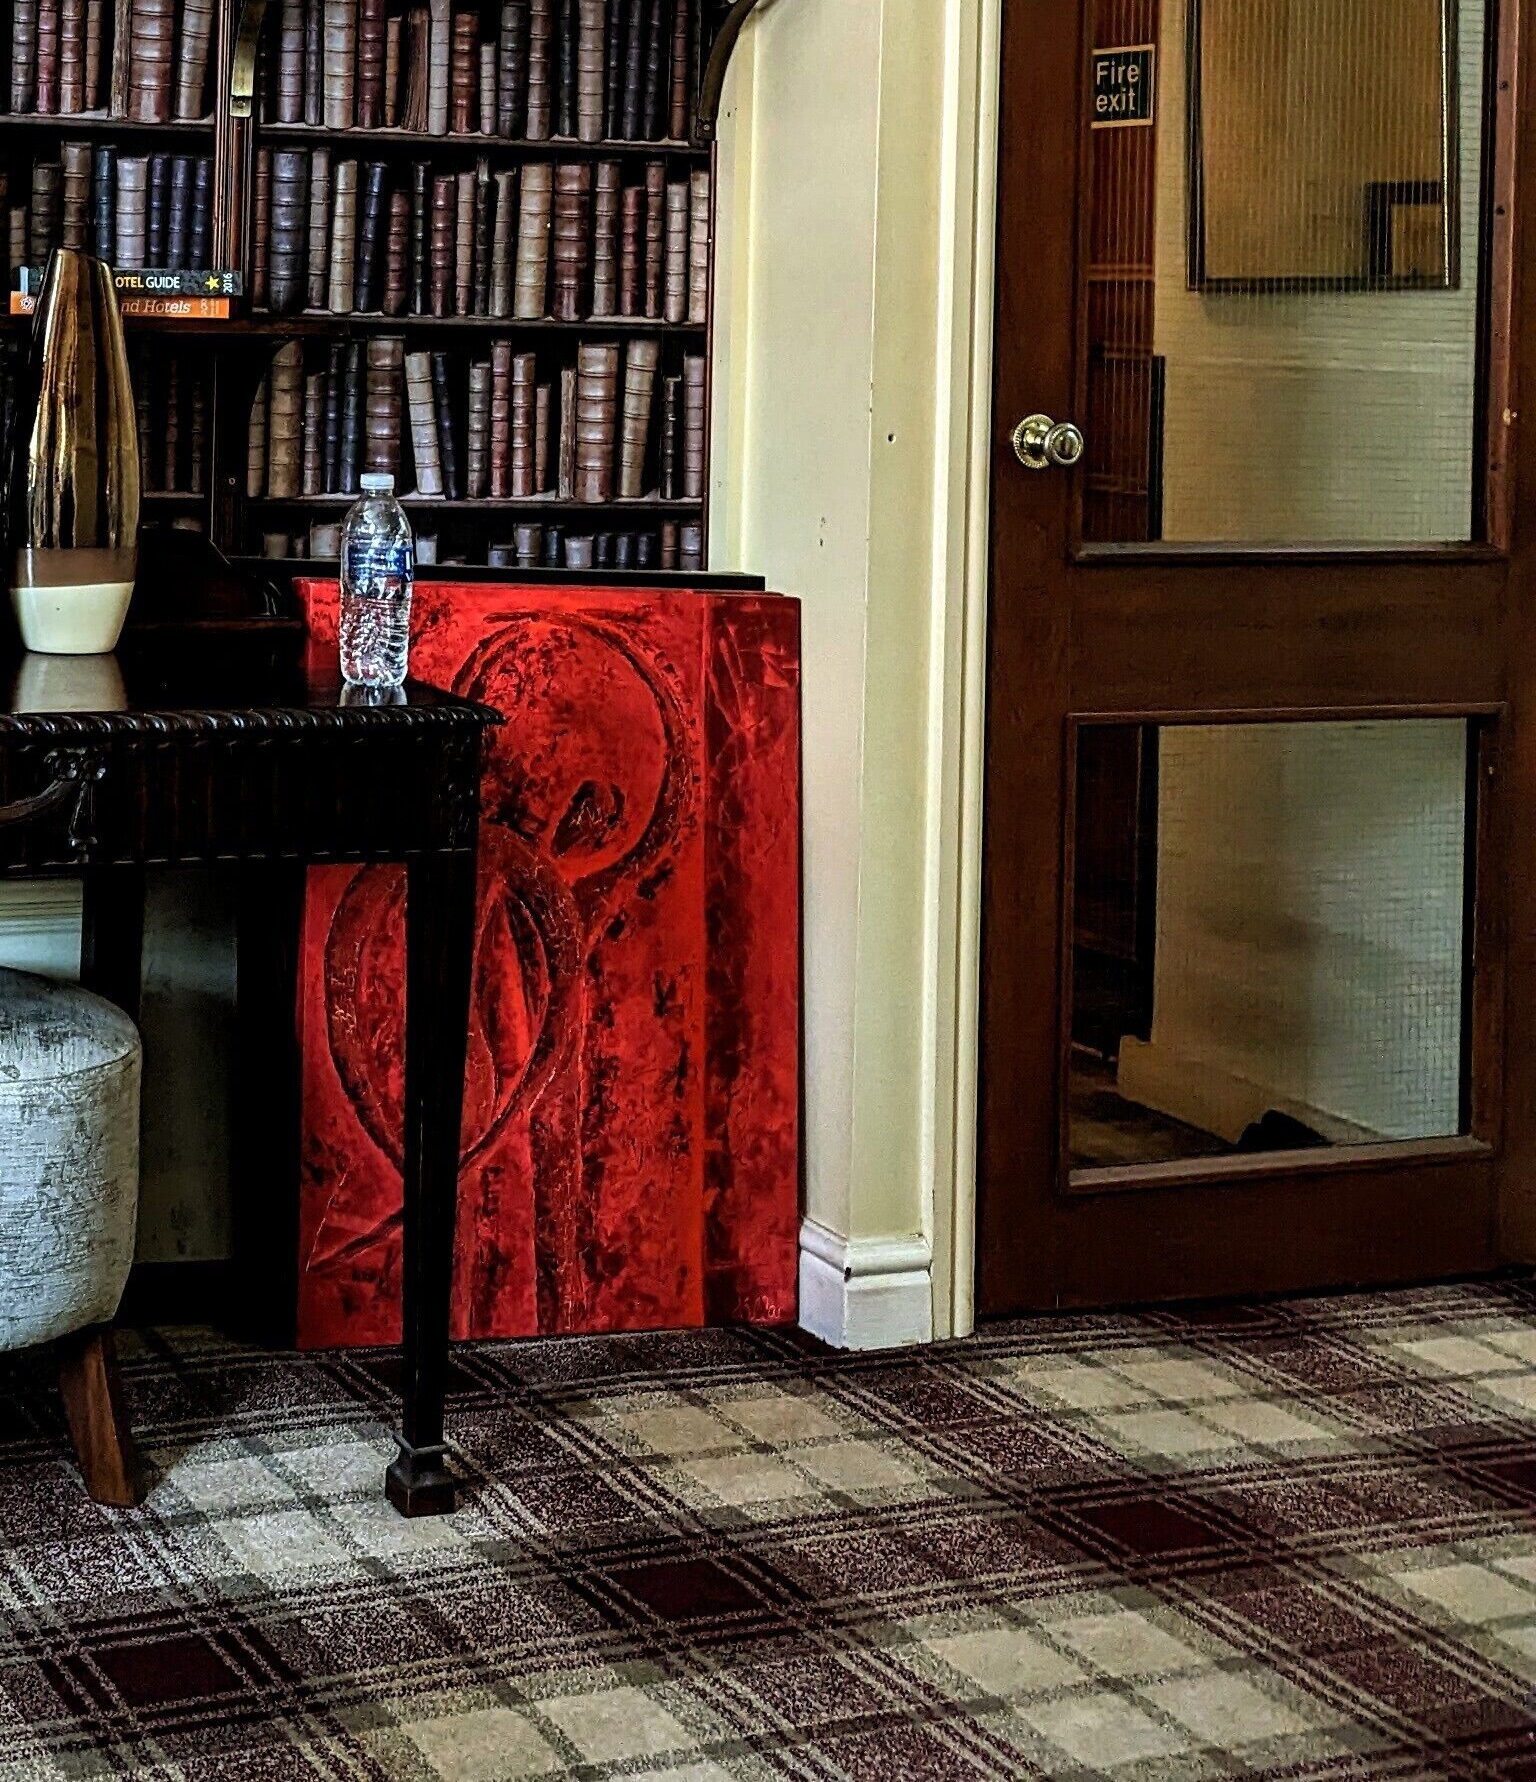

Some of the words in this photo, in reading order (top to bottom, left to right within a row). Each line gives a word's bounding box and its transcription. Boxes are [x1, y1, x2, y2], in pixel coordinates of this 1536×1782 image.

[1096, 60, 1140, 86] Fire
[1096, 87, 1137, 113] exit
[114, 276, 145, 288] OTEL
[146, 276, 181, 289] GUIDE
[222, 272, 233, 293] 2016
[144, 299, 192, 314] Hotels
